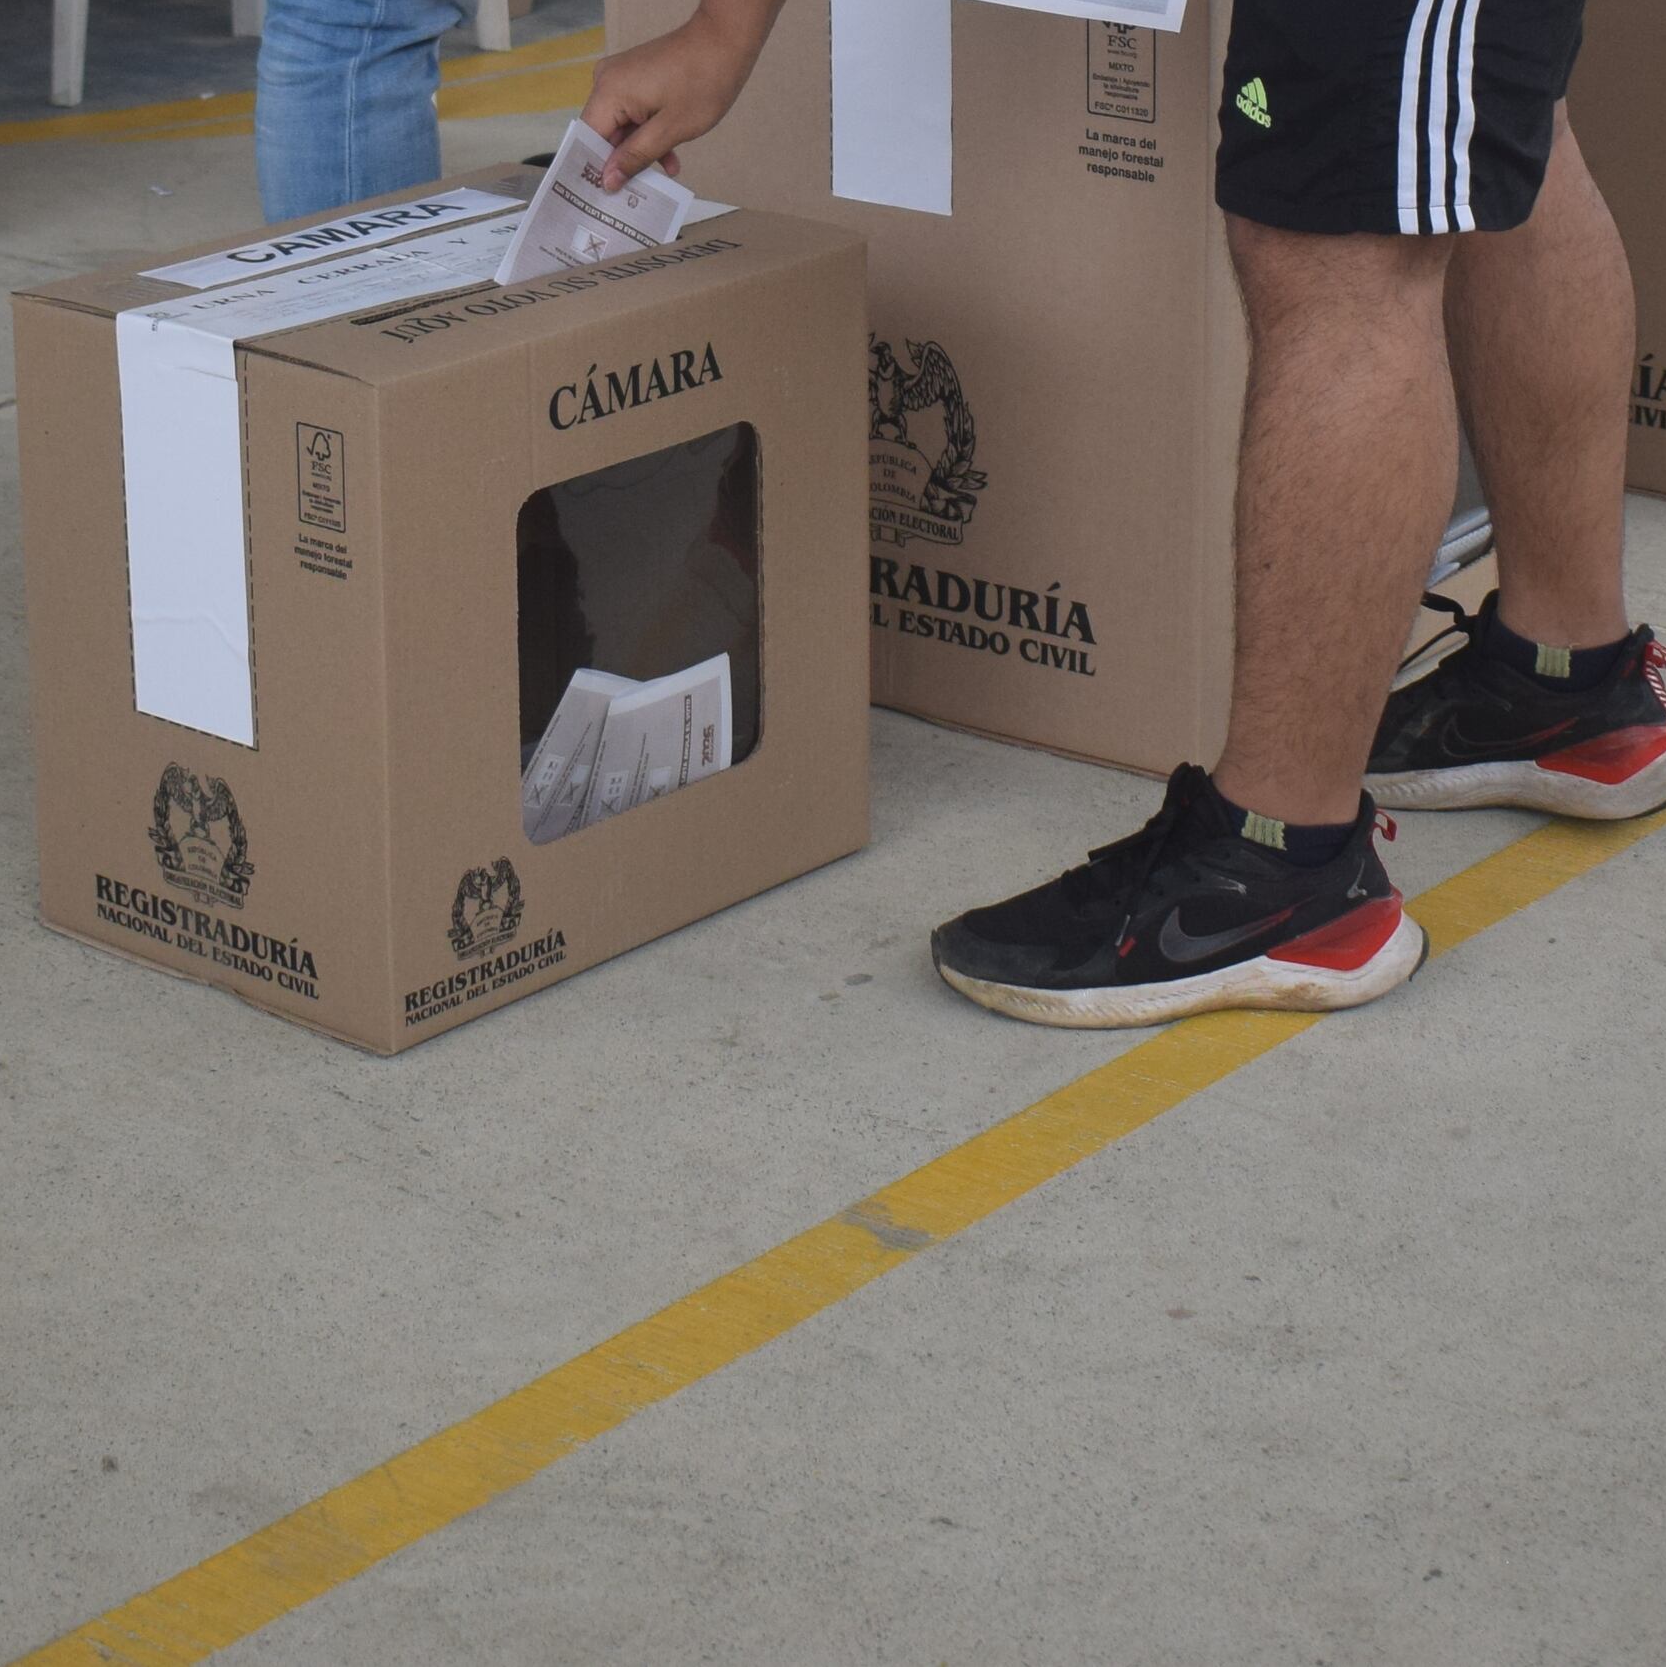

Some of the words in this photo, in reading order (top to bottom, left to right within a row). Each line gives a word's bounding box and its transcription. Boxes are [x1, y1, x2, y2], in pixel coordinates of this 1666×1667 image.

[1108, 34, 1136, 50] FSC
[1109, 61, 1134, 72] MIXTO
[1236, 94, 1272, 128] adidas
[1086, 128, 1098, 141] La
[1102, 133, 1136, 147] marca
[1139, 138, 1156, 150] del
[1079, 145, 1118, 162] manejo
[1122, 150, 1163, 168] forestal
[1087, 163, 1155, 182] responsable
[226, 200, 466, 264] CAMARA
[192, 289, 276, 310] URNA
[298, 248, 430, 285] CERRADA
[448, 237, 469, 247] Y
[592, 239, 743, 281] DEPOSITE
[549, 276, 598, 294] SU
[464, 290, 559, 317] VOTO
[381, 311, 467, 343] AQUÍ
[549, 341, 724, 431] CÁMARA
[311, 461, 332, 474] FSC
[869, 454, 917, 475] EPÚBLICA
[870, 482, 916, 503] OLOMBIA
[899, 513, 959, 541] ELECTORAL
[294, 545, 322, 561] manejo
[324, 552, 353, 569] forestal
[298, 533, 309, 543] La
[310, 537, 333, 551] marca
[335, 543, 347, 554] del
[301, 560, 347, 580] responsable
[869, 555, 1097, 645] RADURÍA
[899, 609, 1011, 656] ESTADO
[1019, 638, 1097, 677] CIVIL
[95, 874, 319, 980] REGISTRADURÍA
[97, 902, 173, 944] NACIONAL
[176, 932, 208, 958] DEL
[212, 946, 273, 982] ESTADO
[277, 970, 320, 1000] CIVIL
[405, 927, 567, 1013] REGISTRADURÍA
[406, 997, 463, 1027] NACIONAL
[466, 984, 489, 1001] DEL
[492, 963, 535, 990] ESTADO
[538, 950, 566, 970] CIVIL
